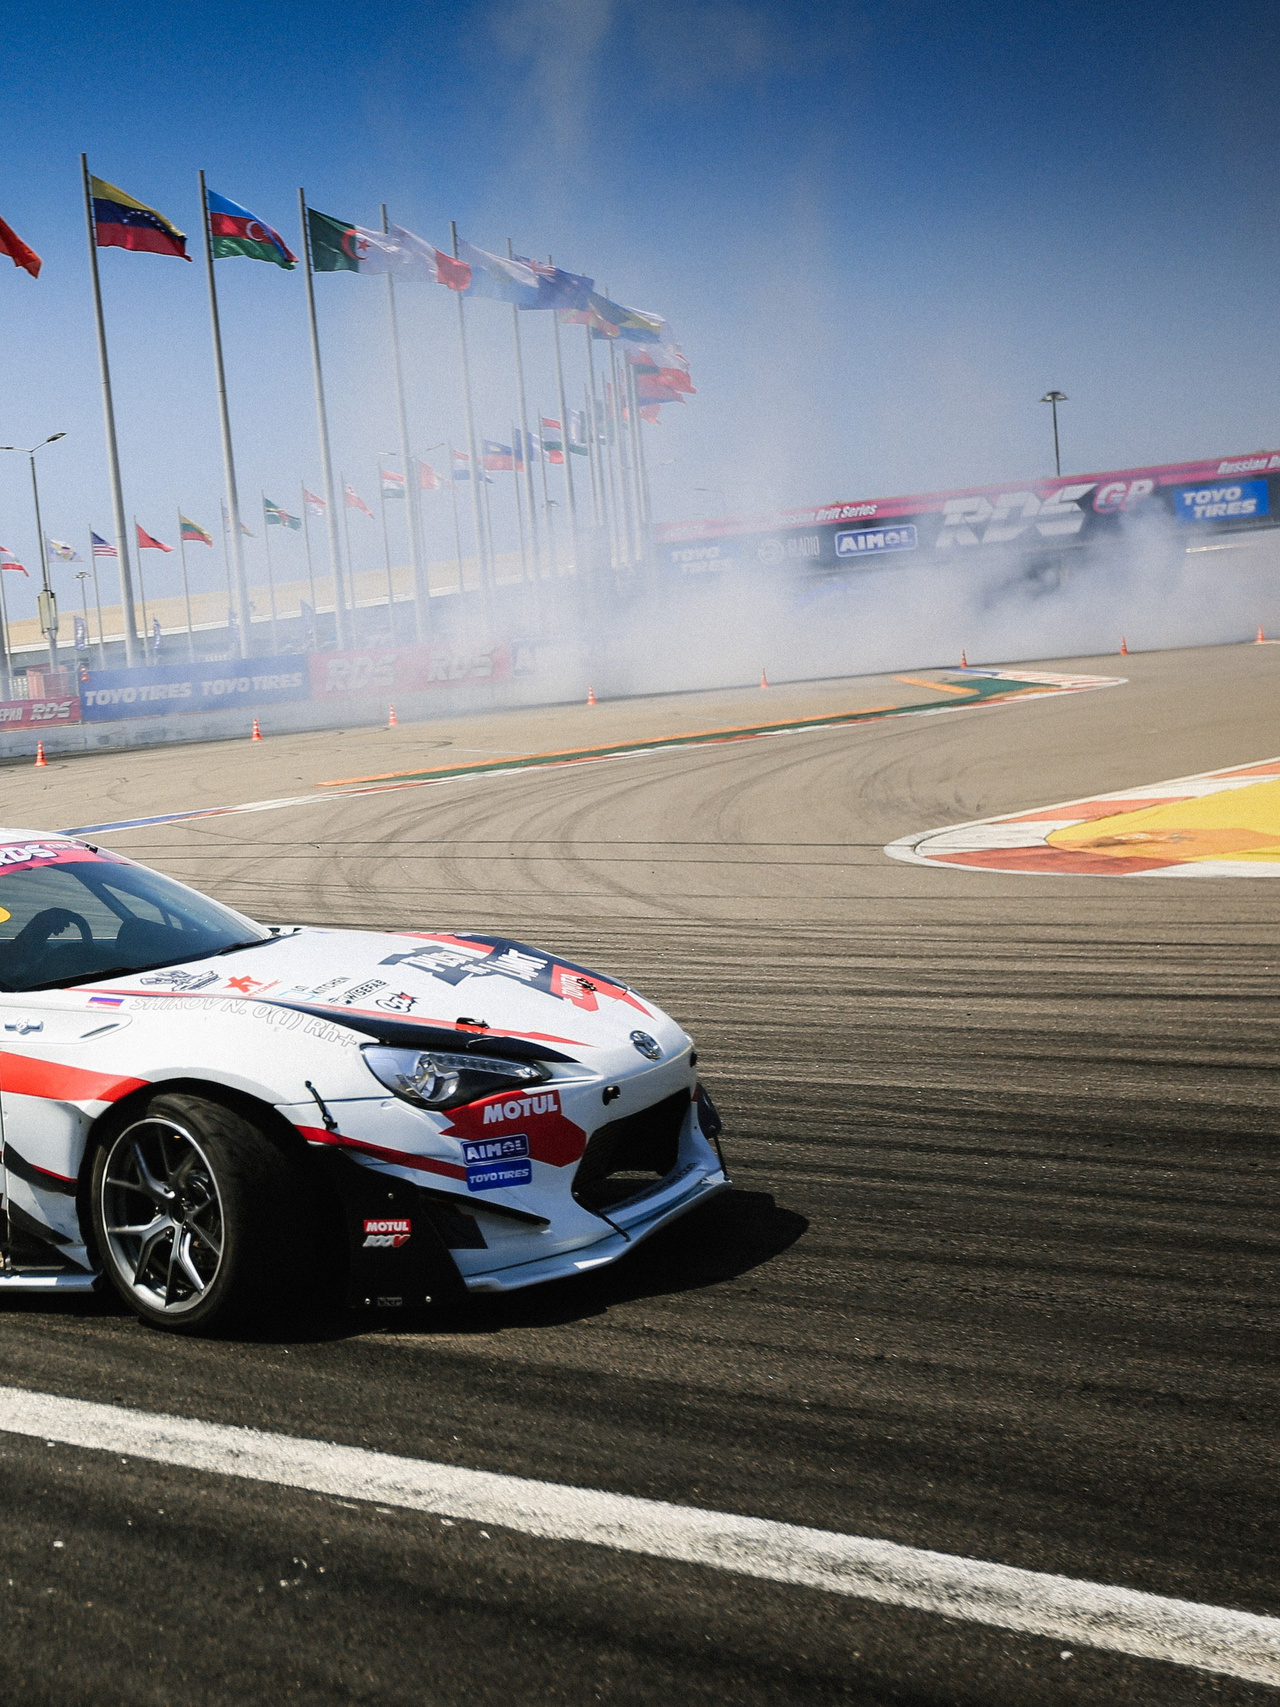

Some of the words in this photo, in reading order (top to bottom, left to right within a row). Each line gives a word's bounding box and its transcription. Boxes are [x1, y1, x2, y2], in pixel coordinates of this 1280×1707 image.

[1217, 457, 1269, 475] Russian
[1183, 486, 1241, 505] TOYO
[816, 507, 841, 521] Drift
[841, 503, 878, 519] Series
[936, 482, 1099, 549] RDS
[1193, 498, 1257, 519] TIRES
[839, 531, 910, 552] AIMOL
[85, 688, 137, 707] TOYO
[138, 682, 192, 701] TIRES
[201, 676, 251, 696] TOYO
[252, 672, 303, 691] TIRES
[30, 700, 74, 721] RDS
[344, 979, 388, 1001] WISEFAB
[483, 1094, 558, 1125] MOTUL
[466, 1140, 526, 1161] AIMOL
[469, 1172, 498, 1184] TOYO
[498, 1168, 529, 1179] TIRES
[366, 1221, 409, 1232] MOTUL
